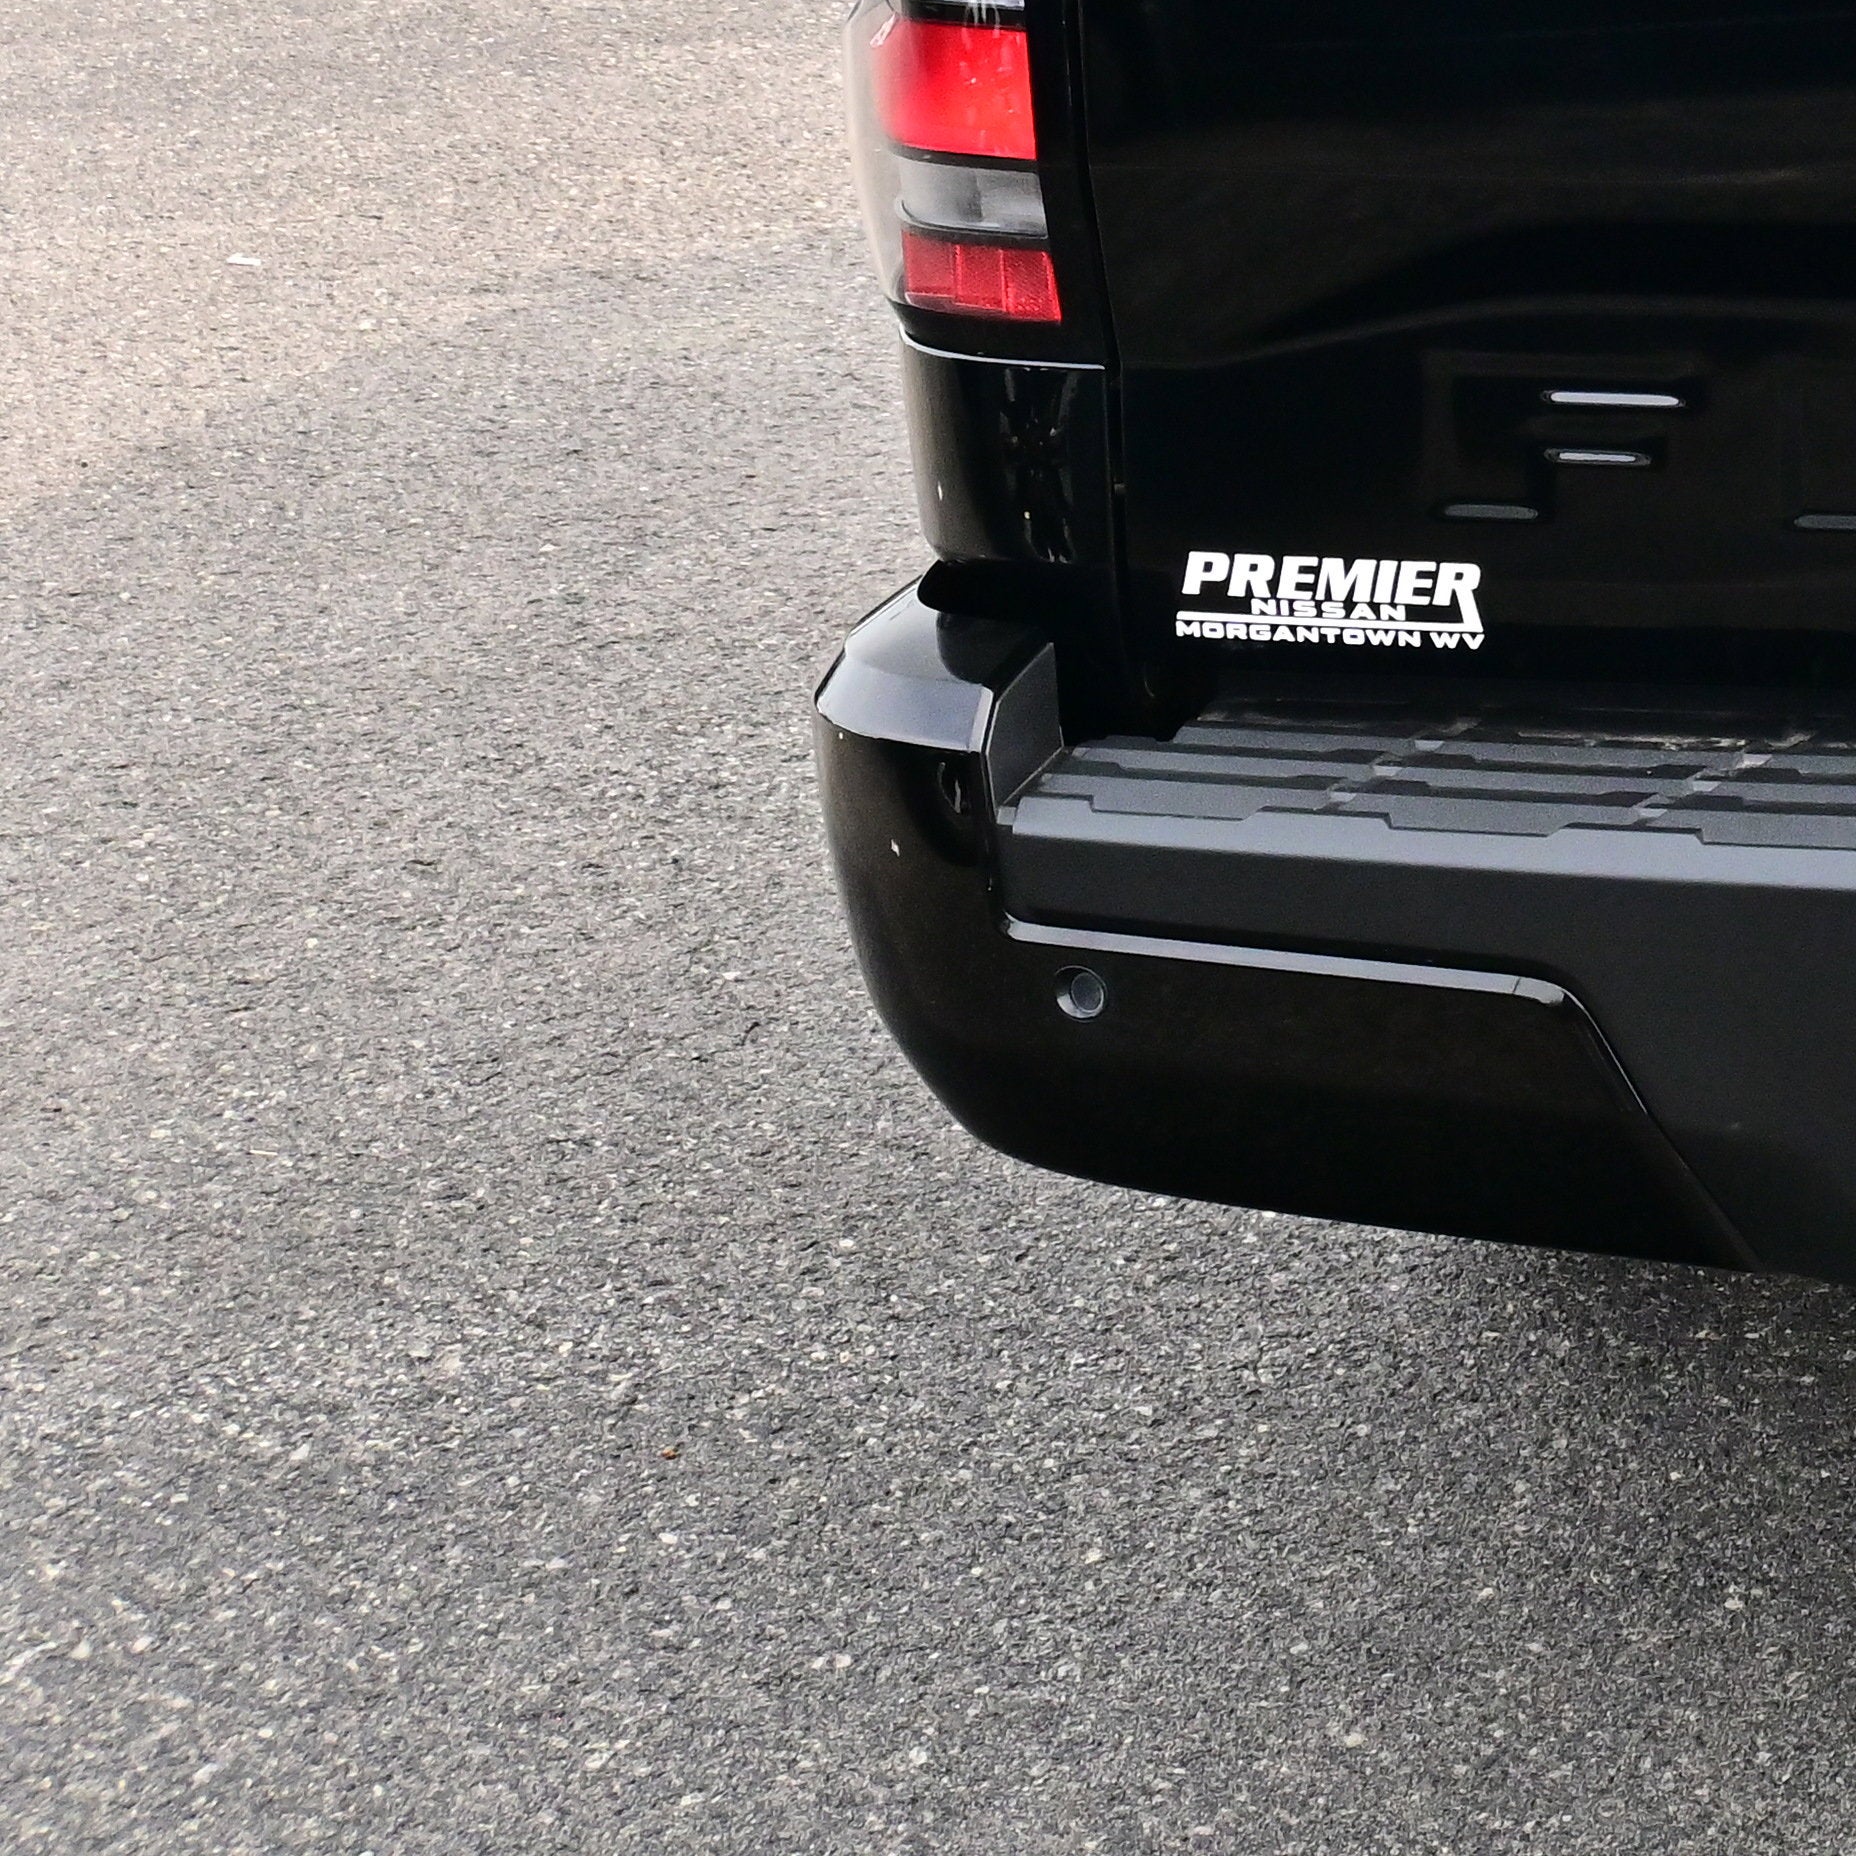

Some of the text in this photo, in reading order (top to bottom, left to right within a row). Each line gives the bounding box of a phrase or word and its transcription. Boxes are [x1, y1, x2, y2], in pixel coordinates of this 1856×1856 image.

[1180, 550, 1484, 610] PREMIER
[1250, 598, 1407, 622] NISSAN
[1175, 620, 1485, 650] MORGANTOWN WV
